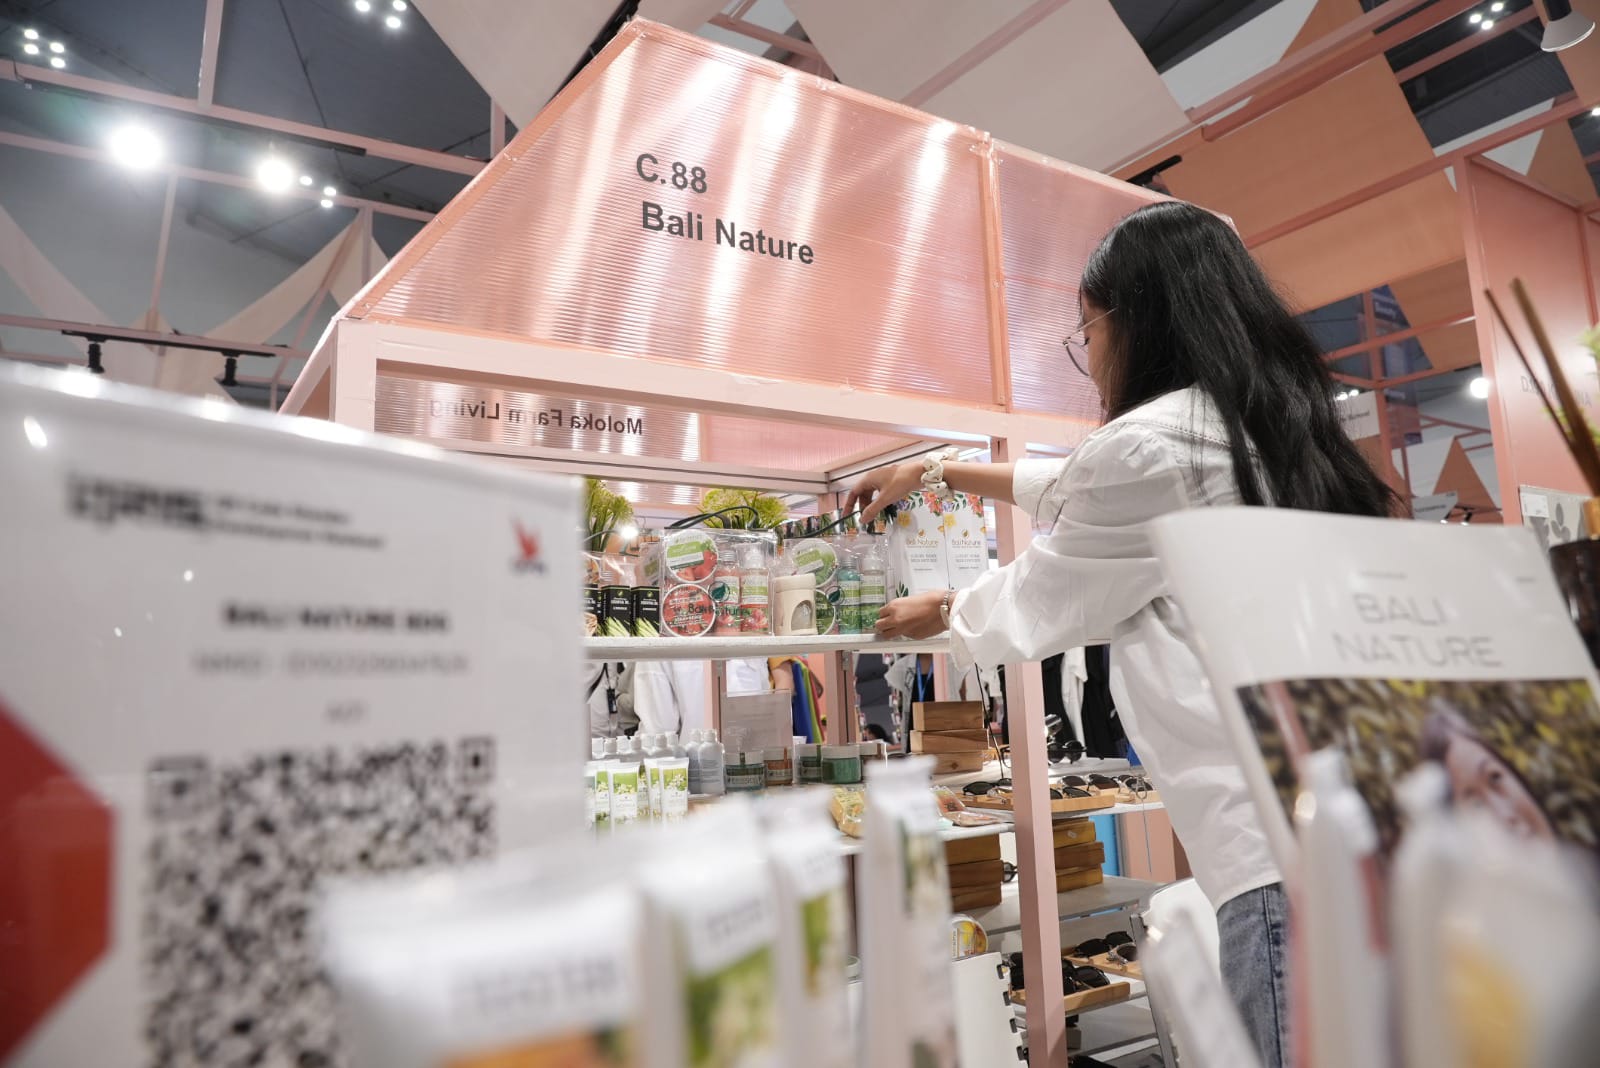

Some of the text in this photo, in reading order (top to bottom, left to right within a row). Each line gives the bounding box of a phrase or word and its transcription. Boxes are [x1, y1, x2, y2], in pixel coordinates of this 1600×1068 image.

[636, 153, 708, 194] C.88
[642, 200, 814, 264] Bali Nature
[1353, 592, 1446, 627] BALI
[1330, 632, 1503, 669] NATURE
